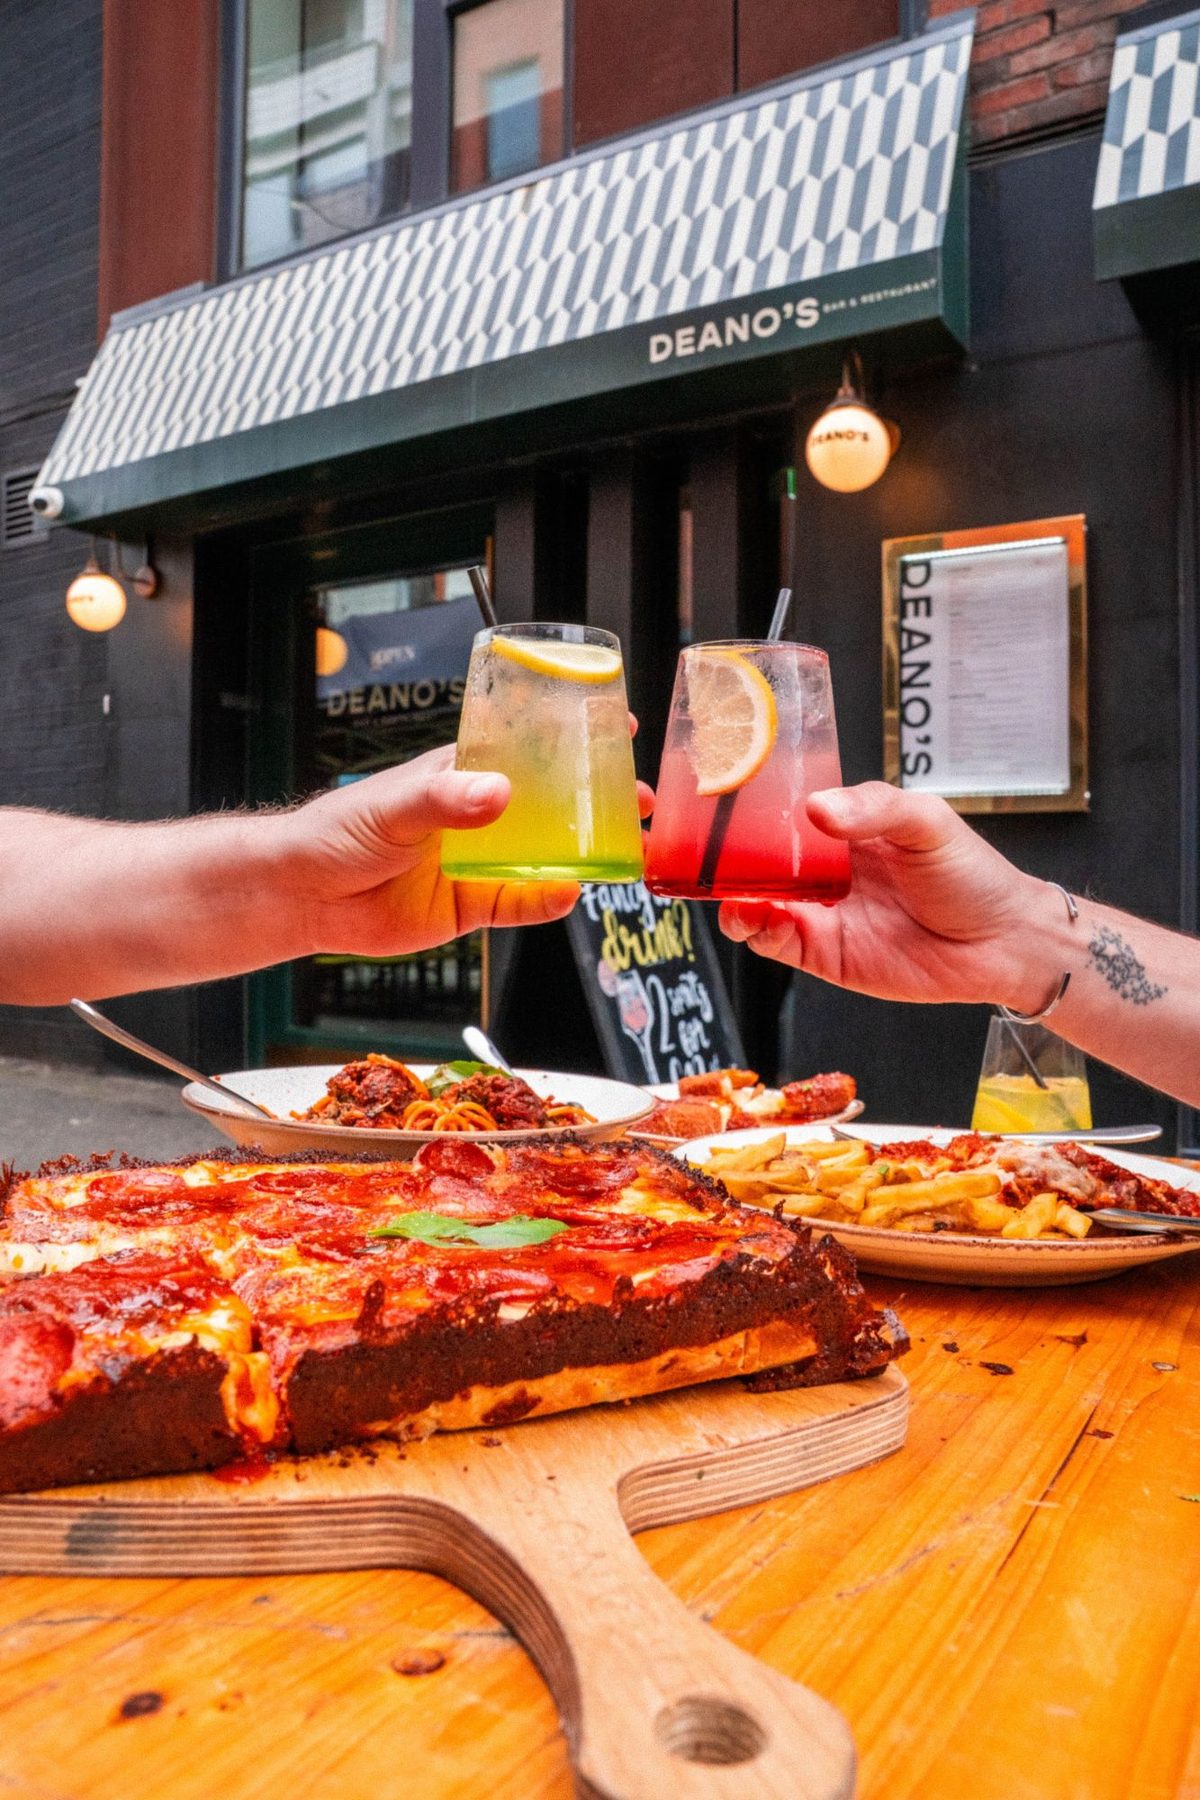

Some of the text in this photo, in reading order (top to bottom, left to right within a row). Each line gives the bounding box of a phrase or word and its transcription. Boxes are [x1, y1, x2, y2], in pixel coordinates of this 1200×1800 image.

[649, 297, 820, 364] DEANO'S
[326, 679, 466, 717] DEANO'S
[900, 558, 932, 778] DEANO'S
[601, 899, 696, 974] drink?
